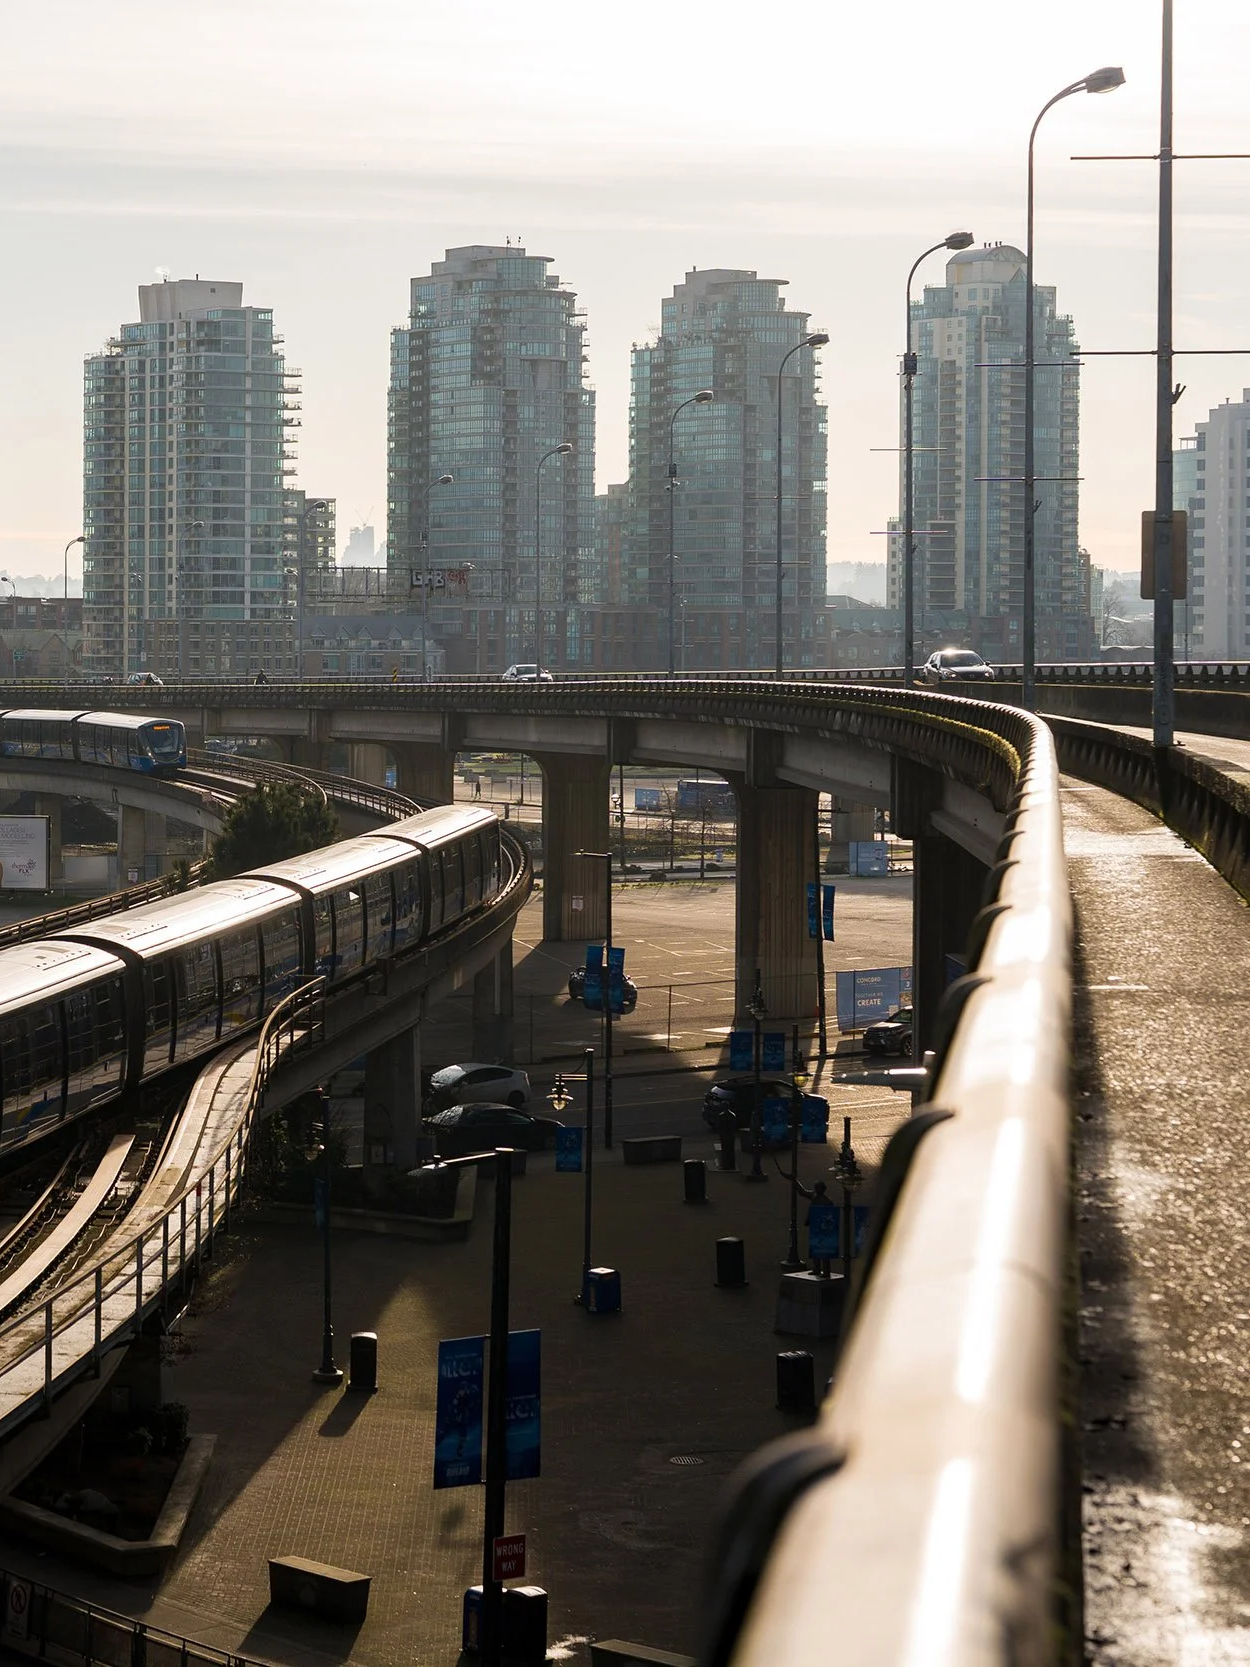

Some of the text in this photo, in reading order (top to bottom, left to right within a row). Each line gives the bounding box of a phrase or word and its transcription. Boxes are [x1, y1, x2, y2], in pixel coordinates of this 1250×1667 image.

[857, 998, 882, 1007] CREATE
[496, 1542, 524, 1557] WRONG
[501, 1560, 517, 1573] WAY
